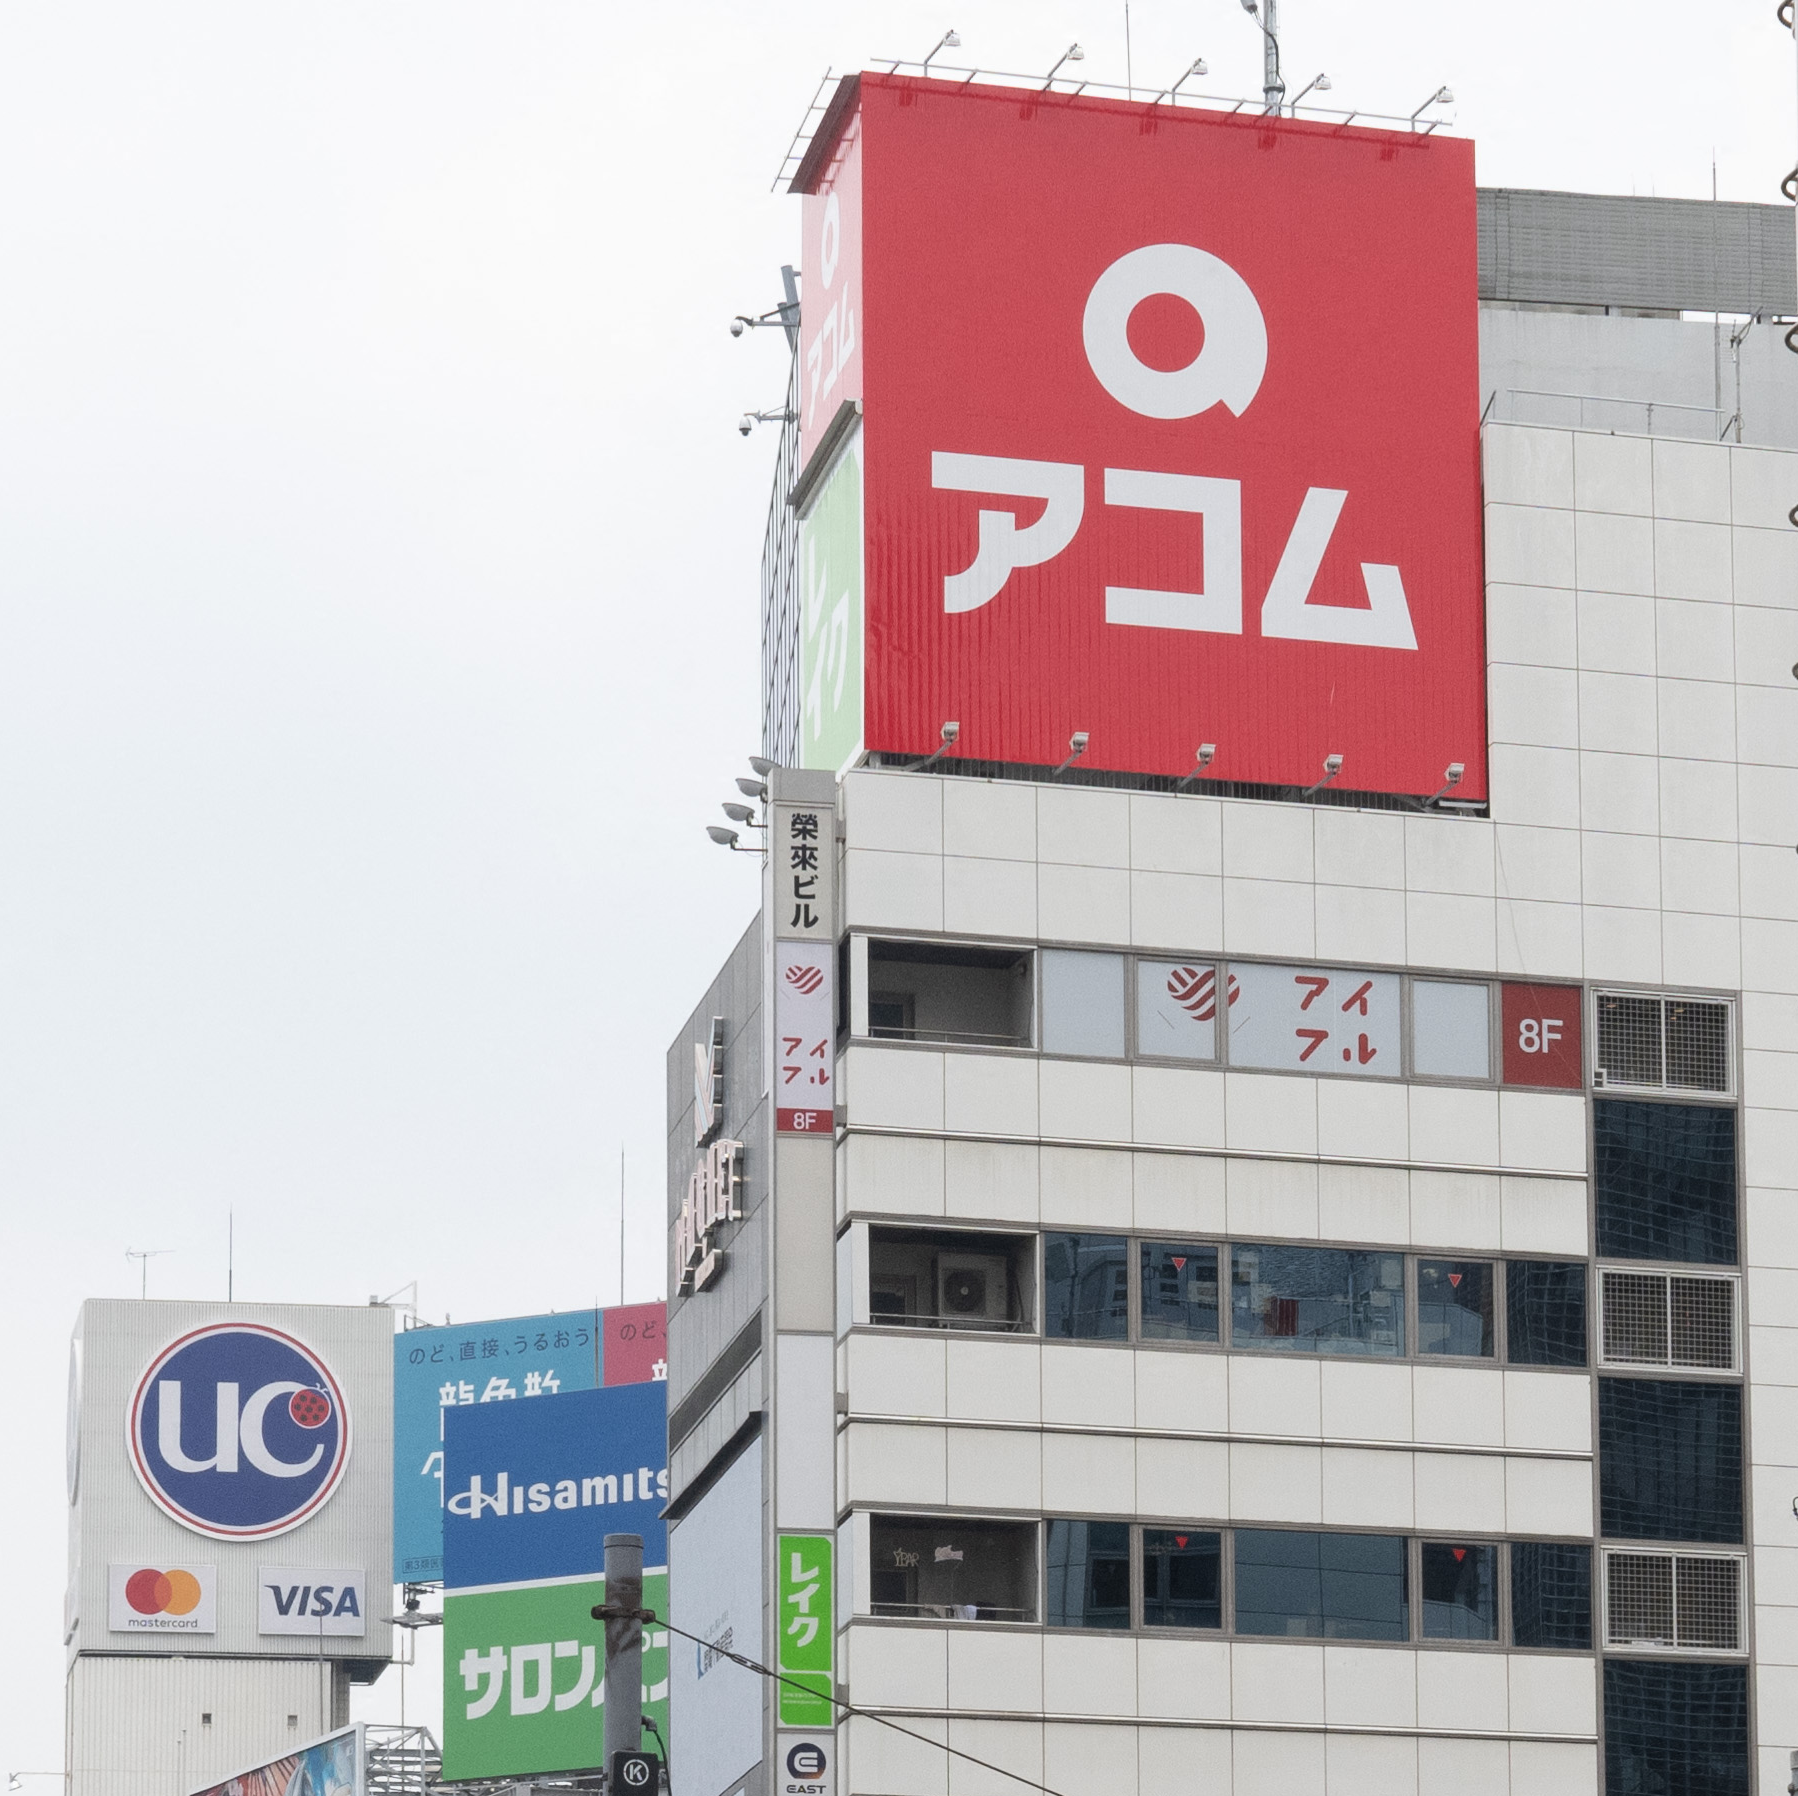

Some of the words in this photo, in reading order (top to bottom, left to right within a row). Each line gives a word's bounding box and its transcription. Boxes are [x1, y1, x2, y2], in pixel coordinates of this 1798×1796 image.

[931, 451, 1419, 651] アコム
[790, 813, 820, 929] 榮來ビル
[1294, 975, 1374, 1017] アイ
[1295, 1028, 1378, 1066] フル
[1518, 1018, 1564, 1055] 8F
[793, 1113, 817, 1130] 8F
[409, 1327, 590, 1366] のど、直接、うるおう
[128, 1617, 198, 1630] mastercard
[264, 1585, 361, 1618] VISA
[787, 1552, 819, 1648] レイク
[786, 1785, 827, 1794] EAST
